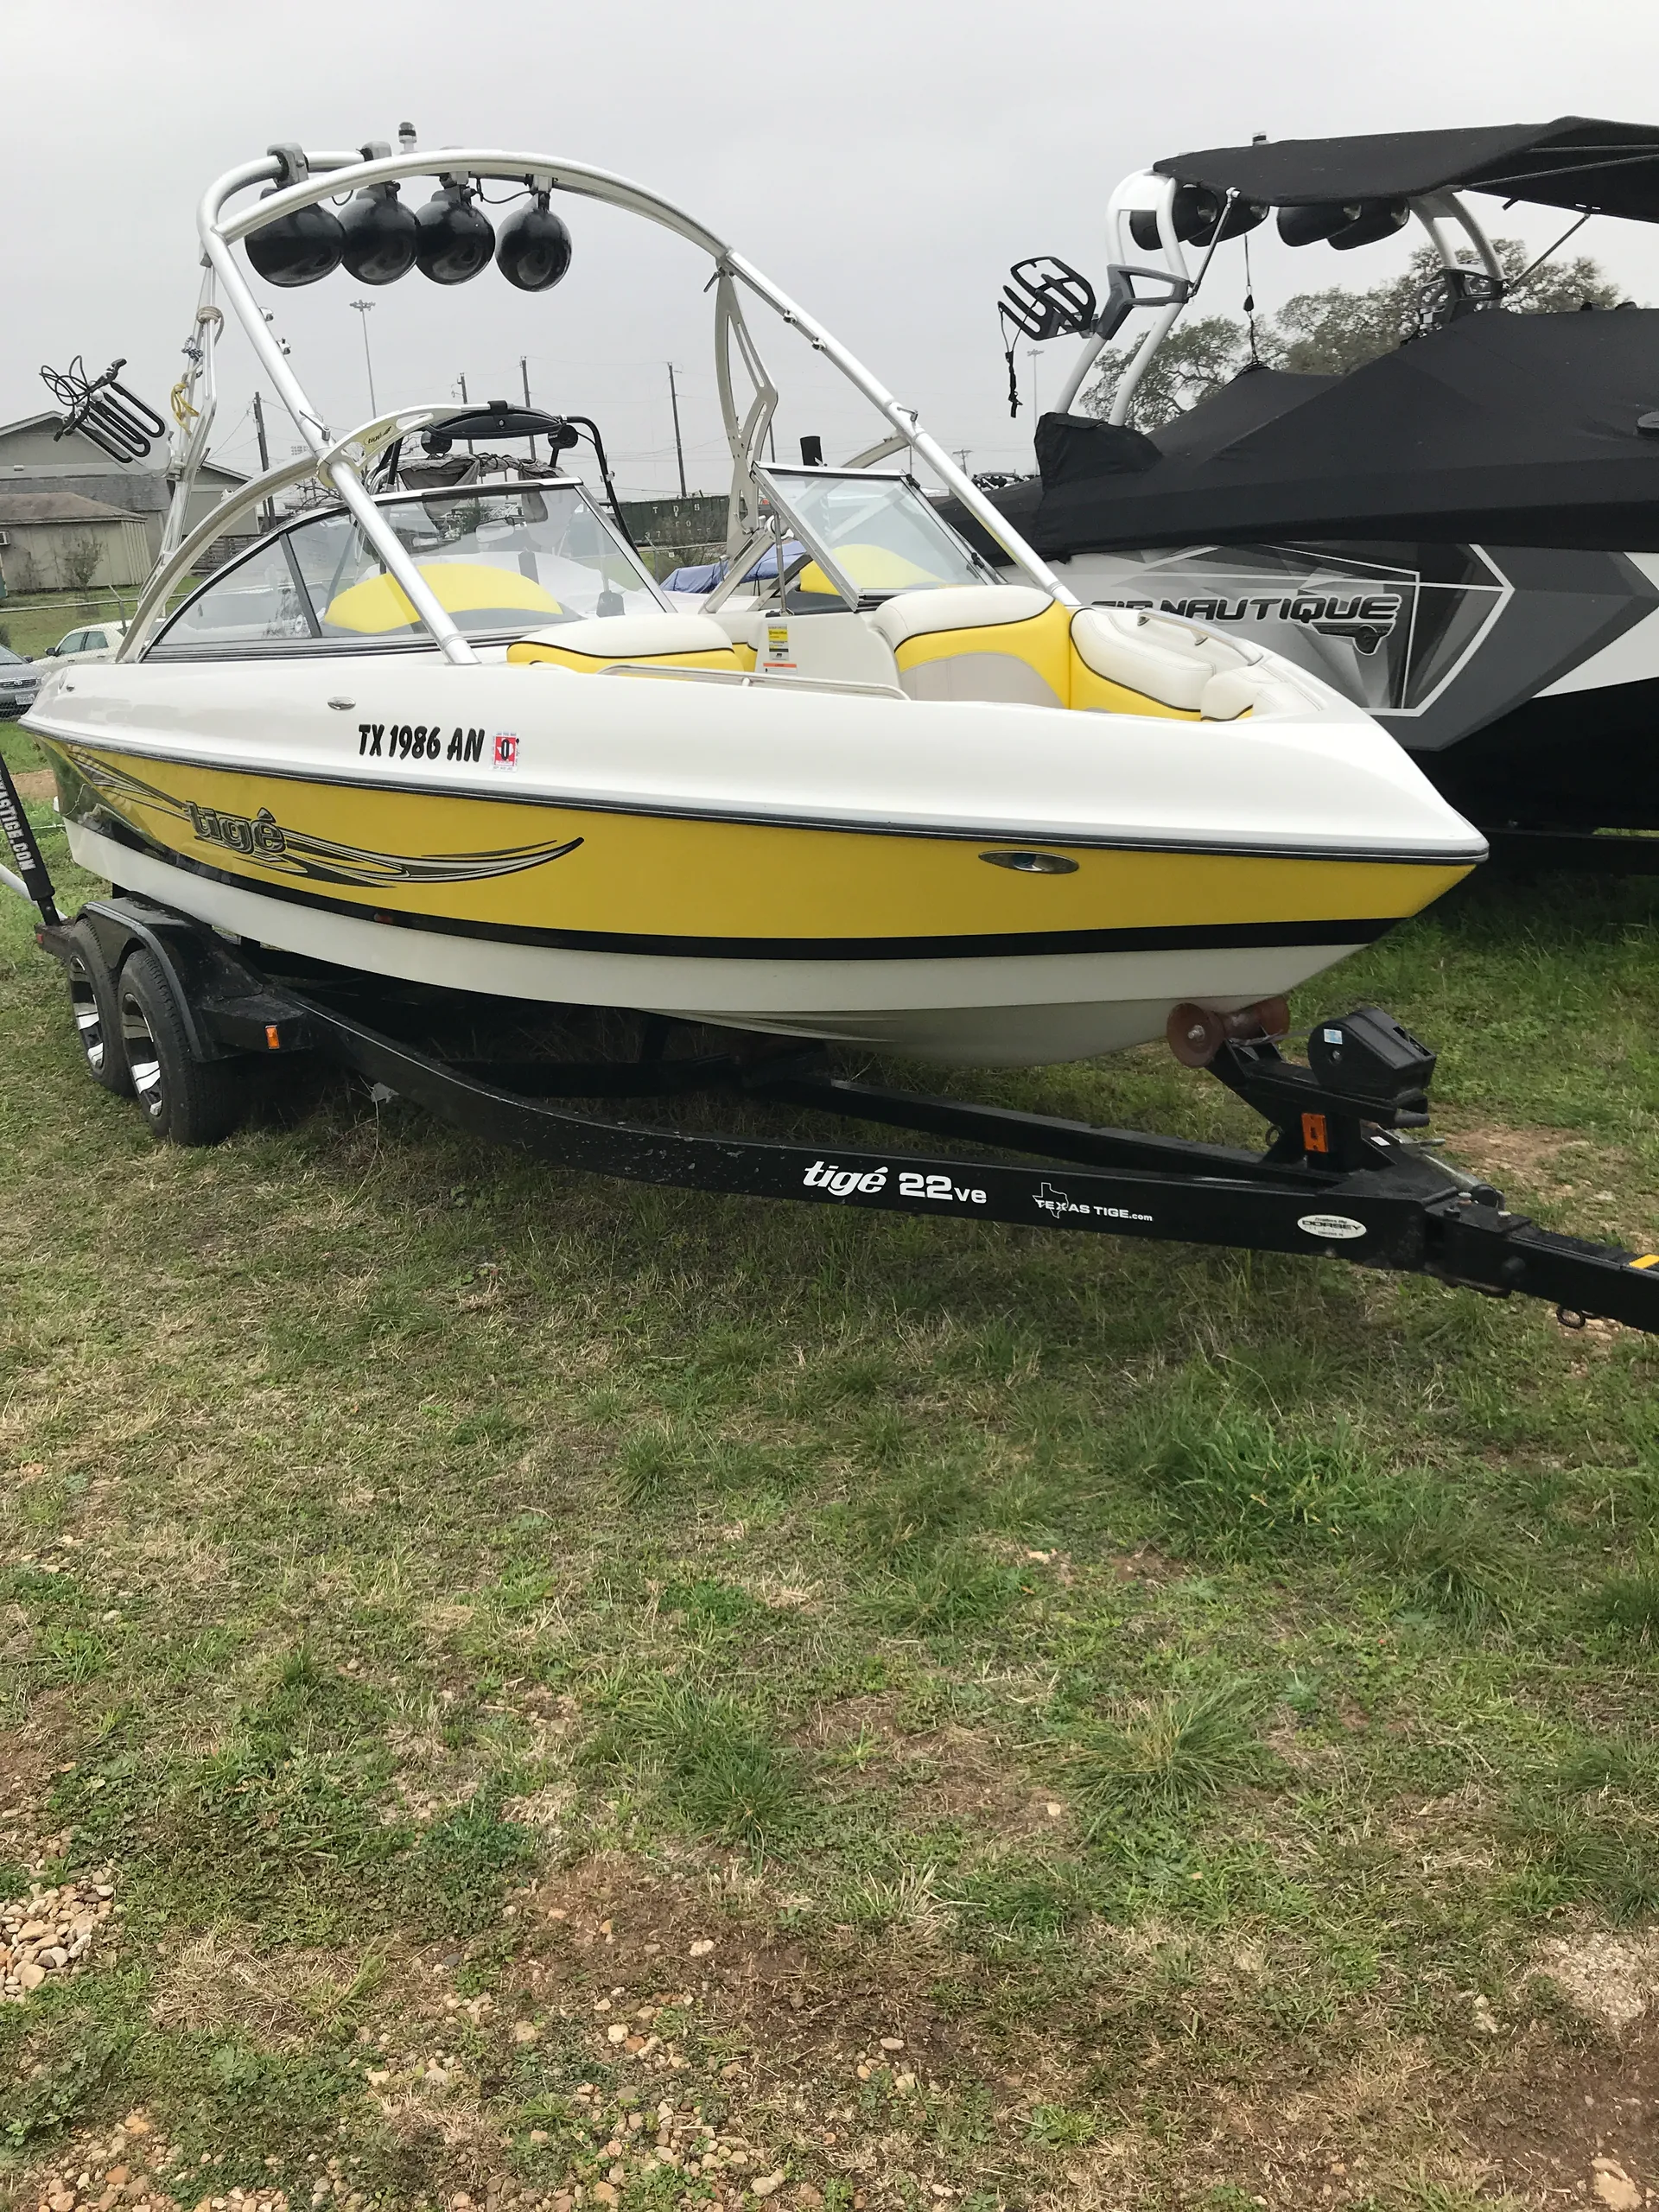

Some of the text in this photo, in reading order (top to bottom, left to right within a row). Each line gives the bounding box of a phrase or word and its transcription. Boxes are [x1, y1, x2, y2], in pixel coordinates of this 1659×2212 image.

[1160, 597, 1401, 623] NAUTIQUE
[359, 724, 385, 757] TX
[389, 724, 441, 760] 1986
[447, 727, 486, 762] AN
[1036, 1199, 1154, 1222] TEXAS TIGE.com
